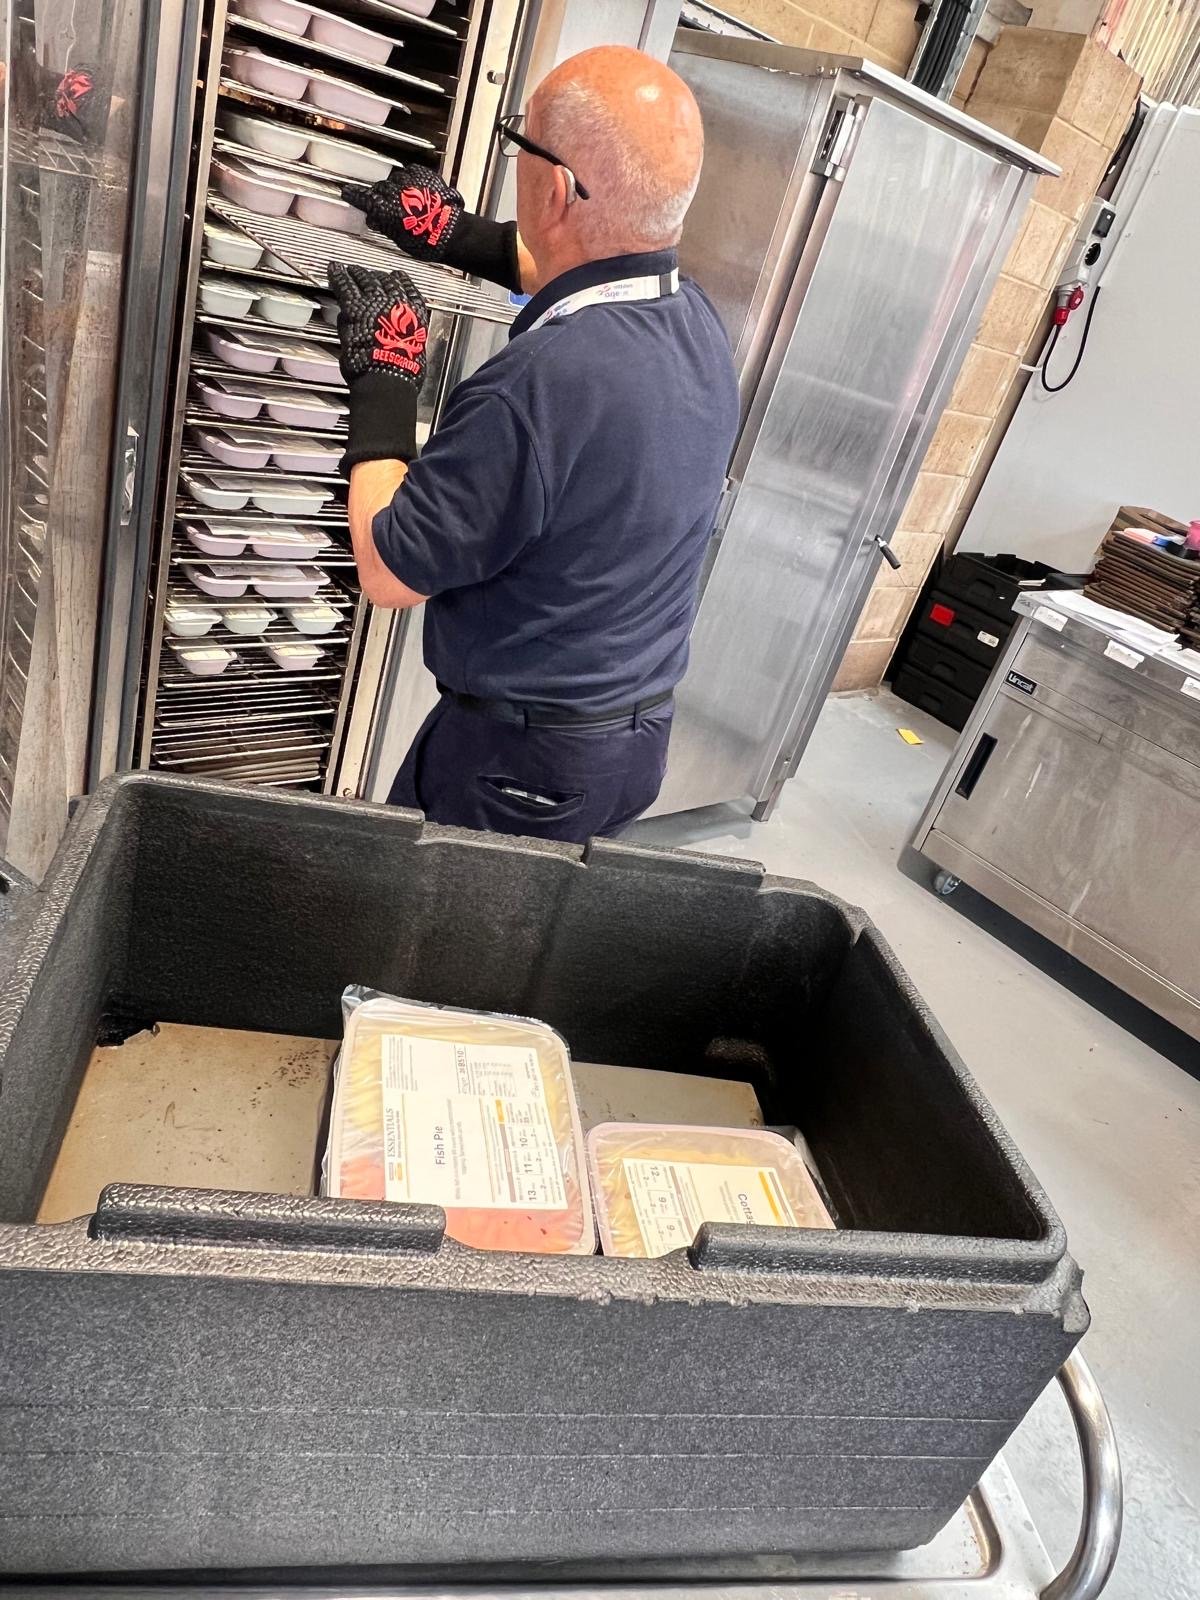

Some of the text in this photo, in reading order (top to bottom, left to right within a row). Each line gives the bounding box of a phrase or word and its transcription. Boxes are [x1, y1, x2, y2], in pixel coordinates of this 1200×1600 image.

[385, 1107, 397, 1158] ESSENTIALS
[433, 1126, 446, 1166] Fish Pie
[519, 1137, 529, 1148] 10
[523, 1162, 534, 1174] 11
[649, 1165, 660, 1177] 12
[527, 1190, 538, 1202] 13
